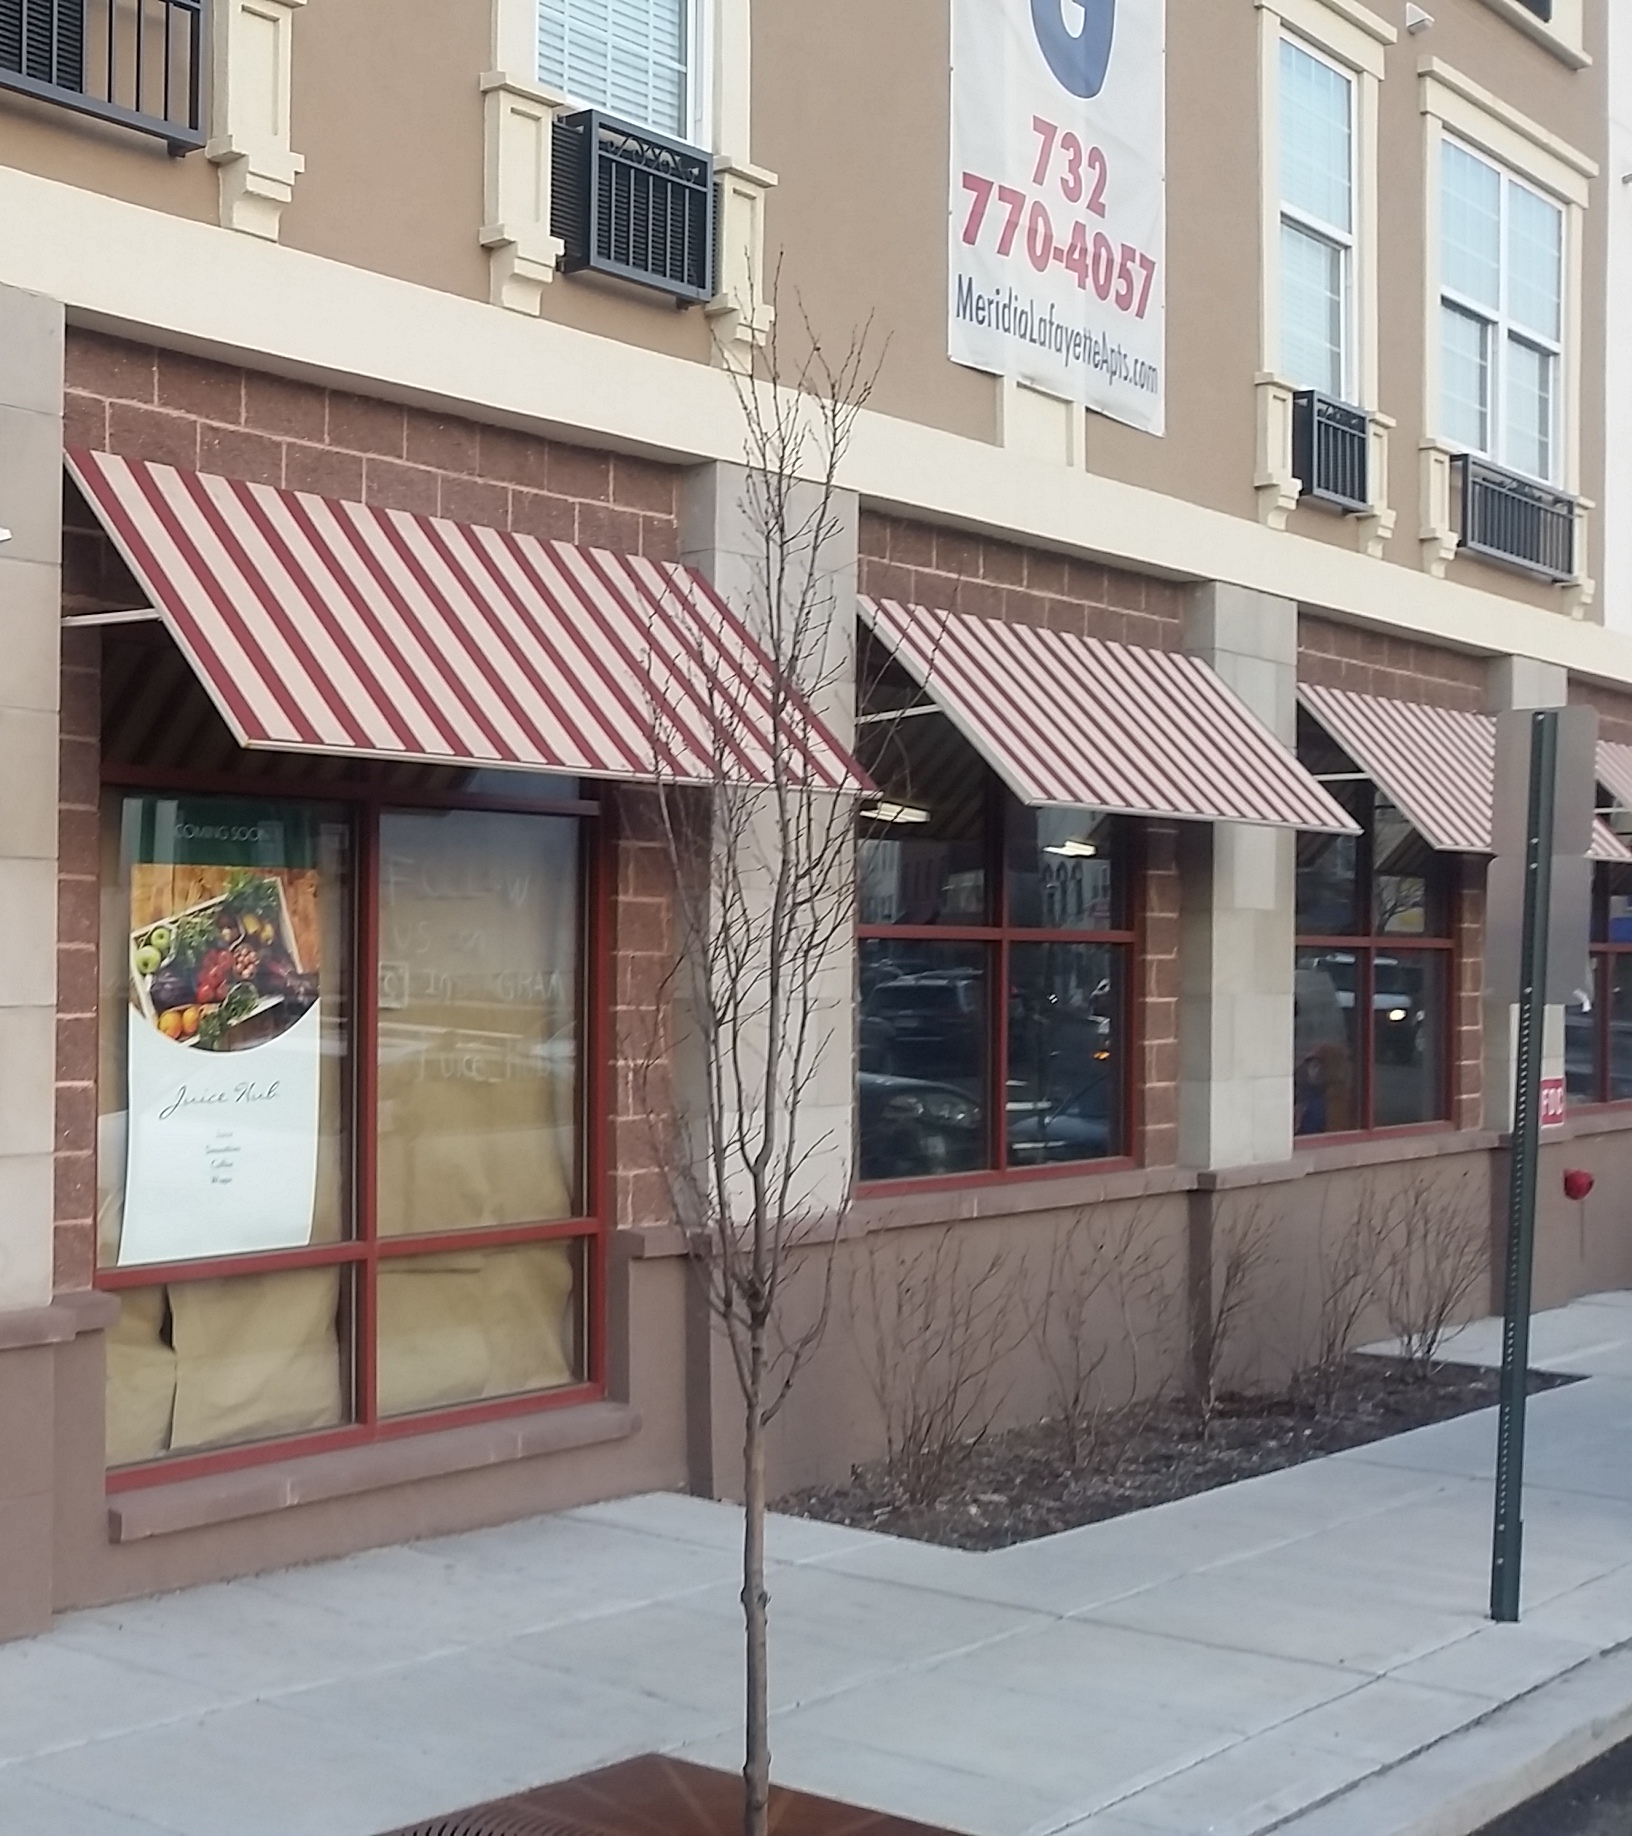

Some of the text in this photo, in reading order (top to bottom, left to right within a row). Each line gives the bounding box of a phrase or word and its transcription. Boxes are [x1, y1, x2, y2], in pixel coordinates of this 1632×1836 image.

[1032, 115, 1107, 218] 732
[962, 172, 1156, 319] 770-4057
[955, 274, 1158, 394] MeridiaLafayetteApts.com
[159, 1080, 280, 1120] Juice Hub
